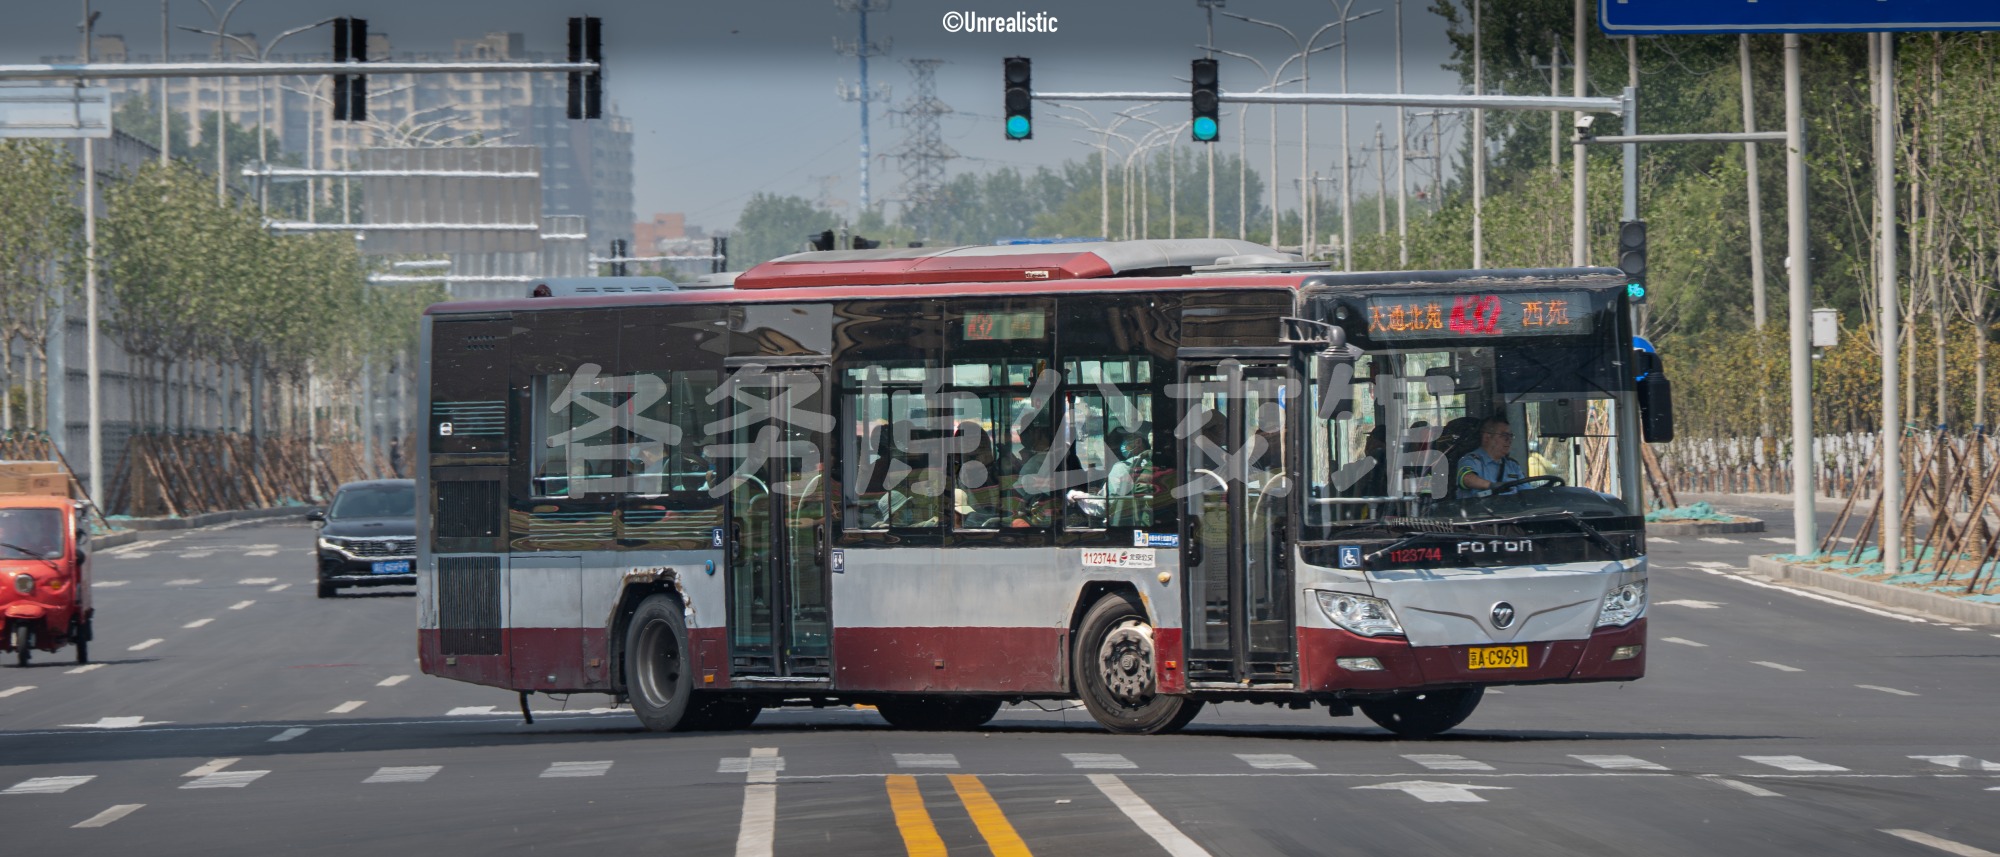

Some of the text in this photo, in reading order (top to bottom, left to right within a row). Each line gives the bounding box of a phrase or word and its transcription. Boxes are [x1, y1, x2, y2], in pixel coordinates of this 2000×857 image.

[967, 311, 993, 340] 432
[1368, 295, 1570, 335] 天通北苑 432 西苑
[1083, 552, 1117, 565] 1123744
[1390, 546, 1442, 564] 1123744
